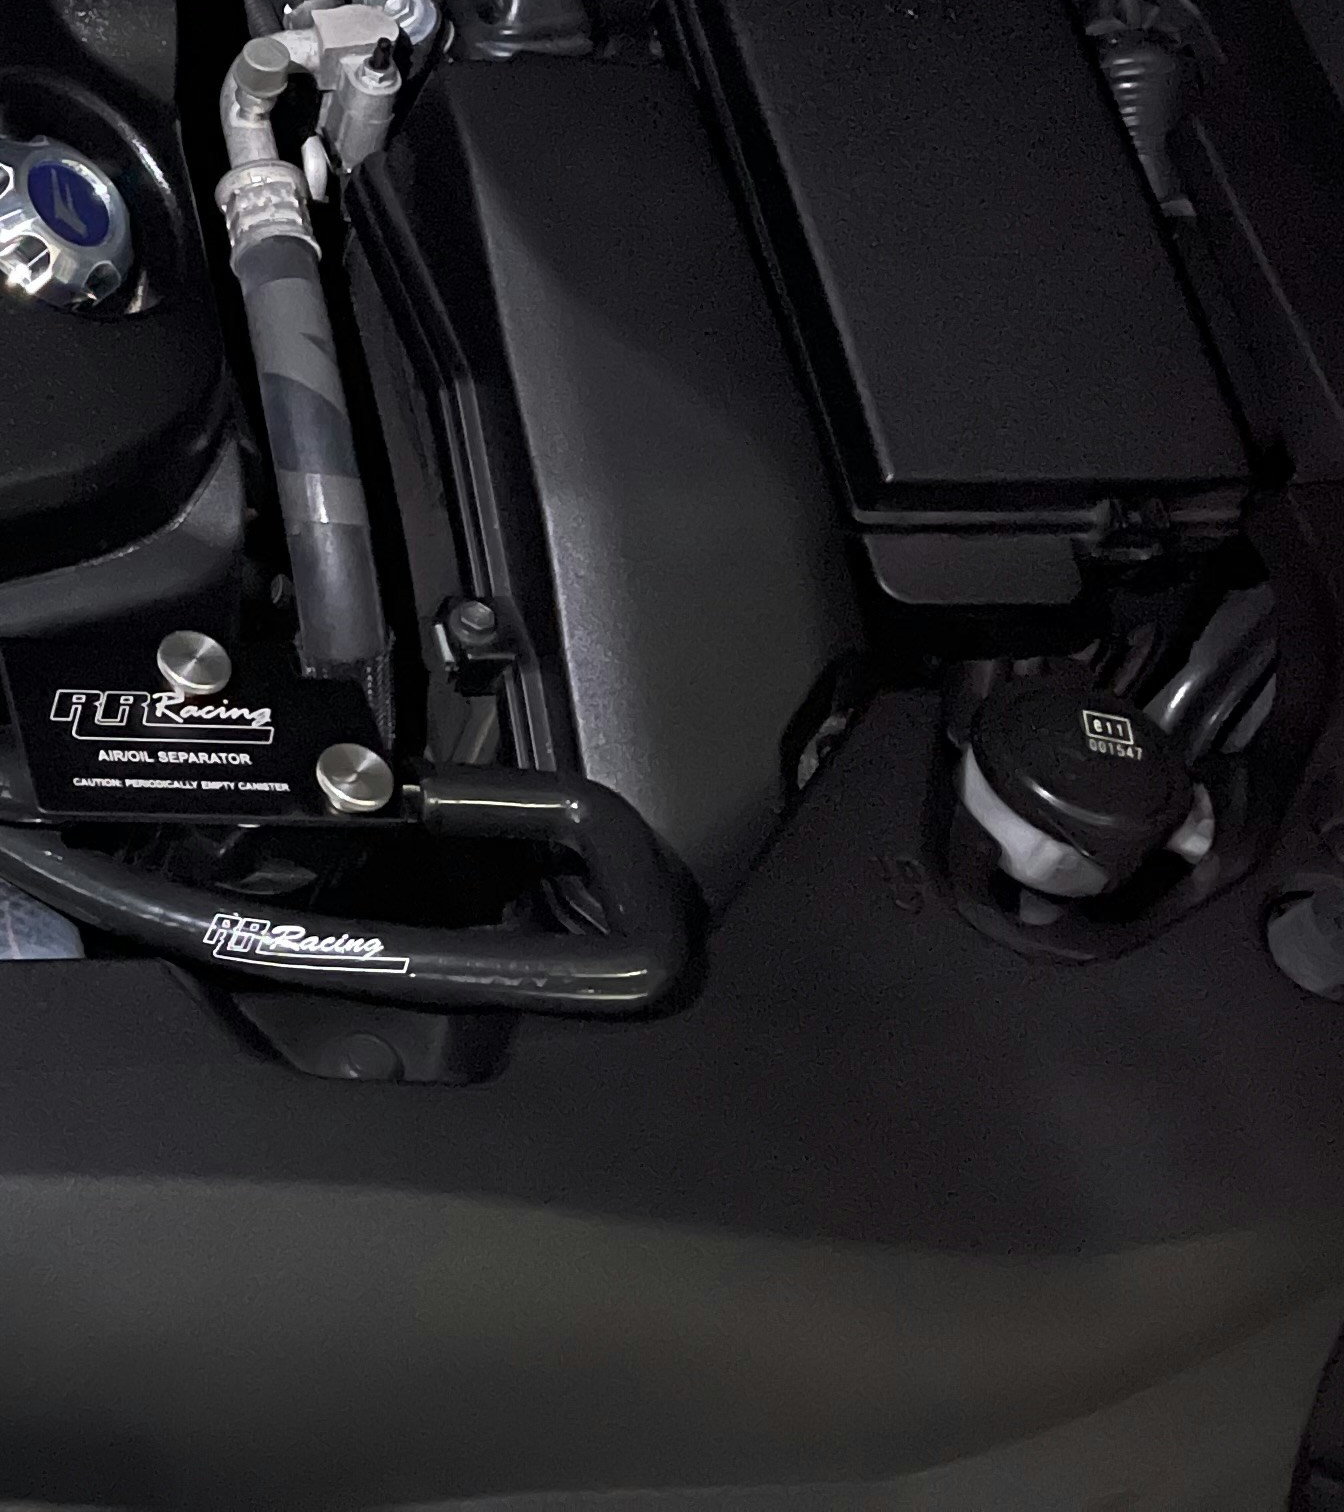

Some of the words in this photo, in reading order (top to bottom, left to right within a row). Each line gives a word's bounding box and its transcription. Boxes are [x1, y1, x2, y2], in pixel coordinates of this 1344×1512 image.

[153, 692, 272, 727] Racing
[98, 749, 154, 763] AIR/OIL
[158, 751, 252, 765] SEPARATOR
[1088, 738, 1143, 761] 001547
[73, 777, 122, 788] CAUTION:
[125, 779, 197, 789] PERIODICALLY
[201, 781, 235, 791] EMPTY
[238, 782, 291, 792] CANISTER
[269, 925, 385, 961] Racing
